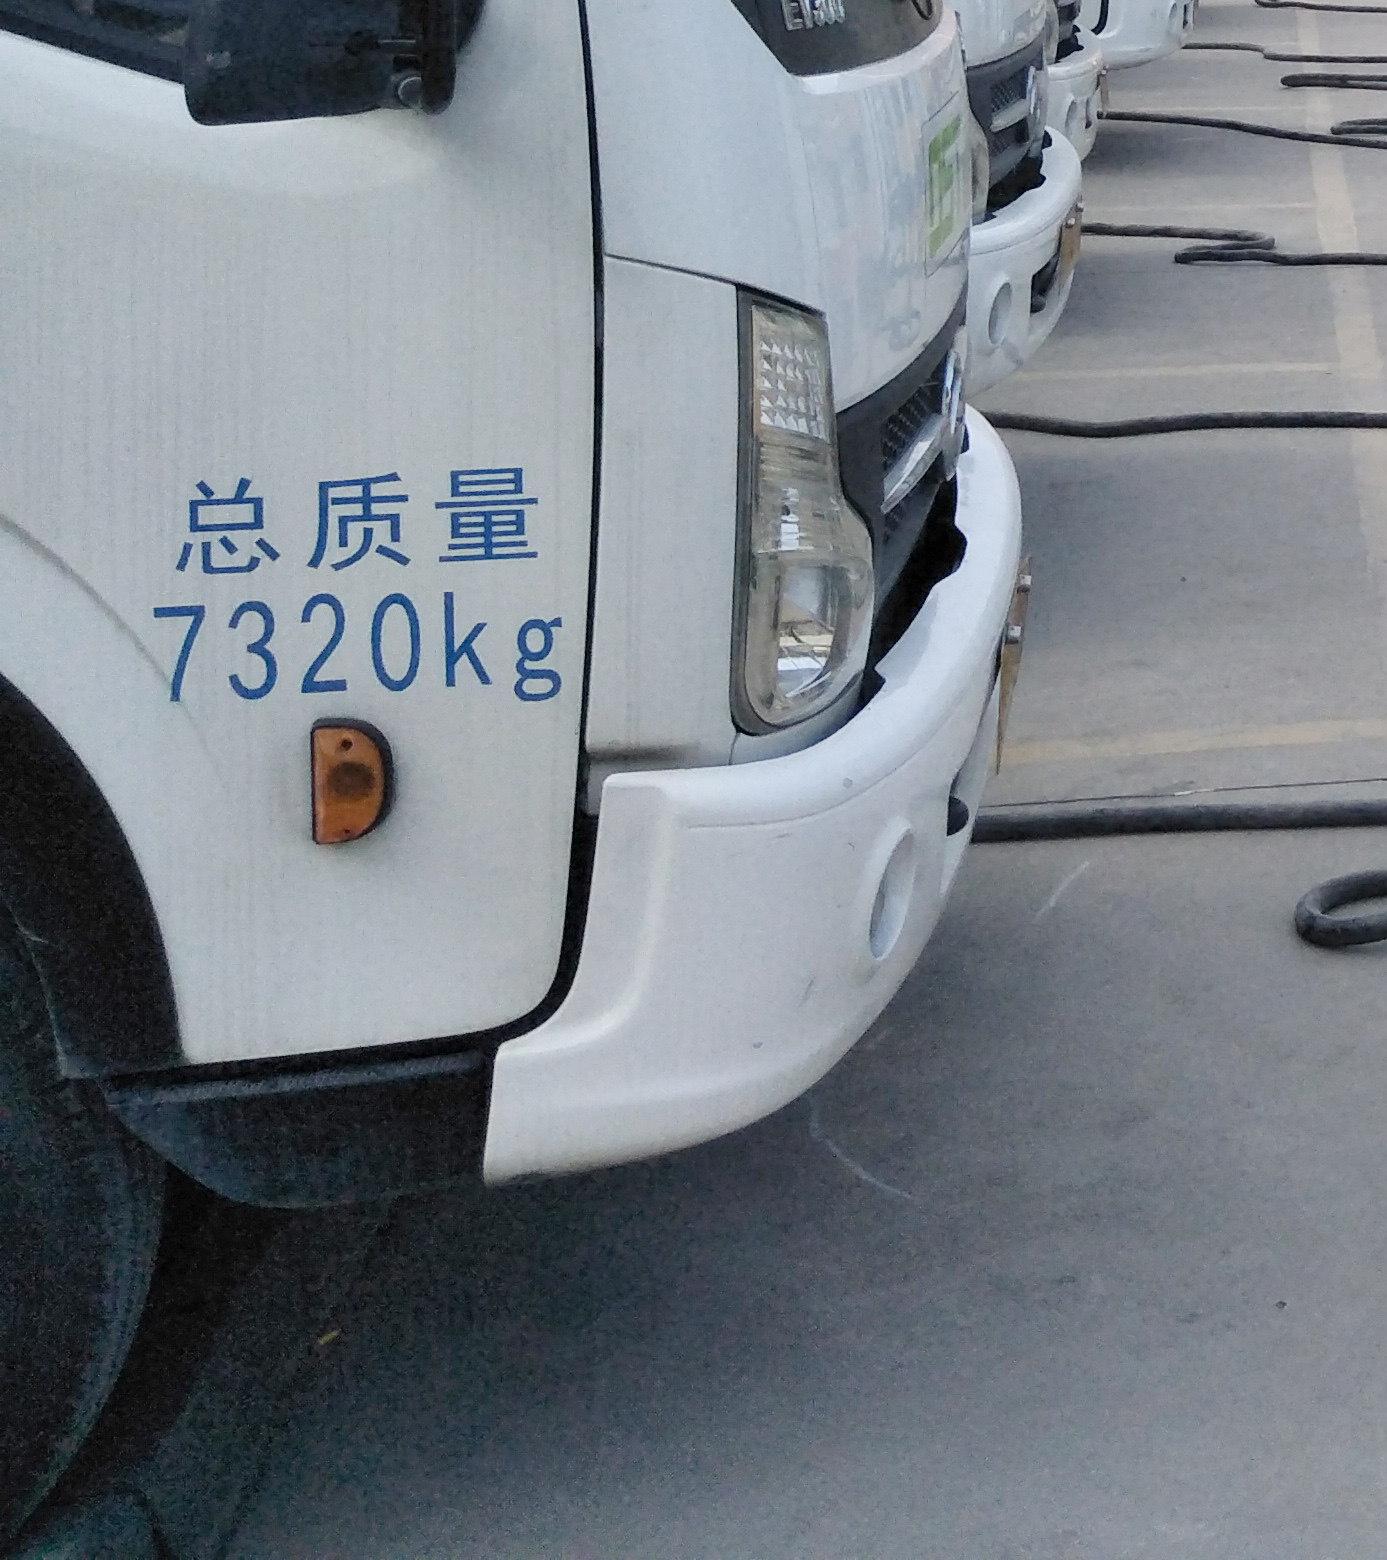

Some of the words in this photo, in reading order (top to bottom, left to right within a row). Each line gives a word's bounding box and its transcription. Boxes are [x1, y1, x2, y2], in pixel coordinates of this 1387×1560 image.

[174, 466, 540, 575] 总质量
[152, 591, 564, 703] 7320kg
